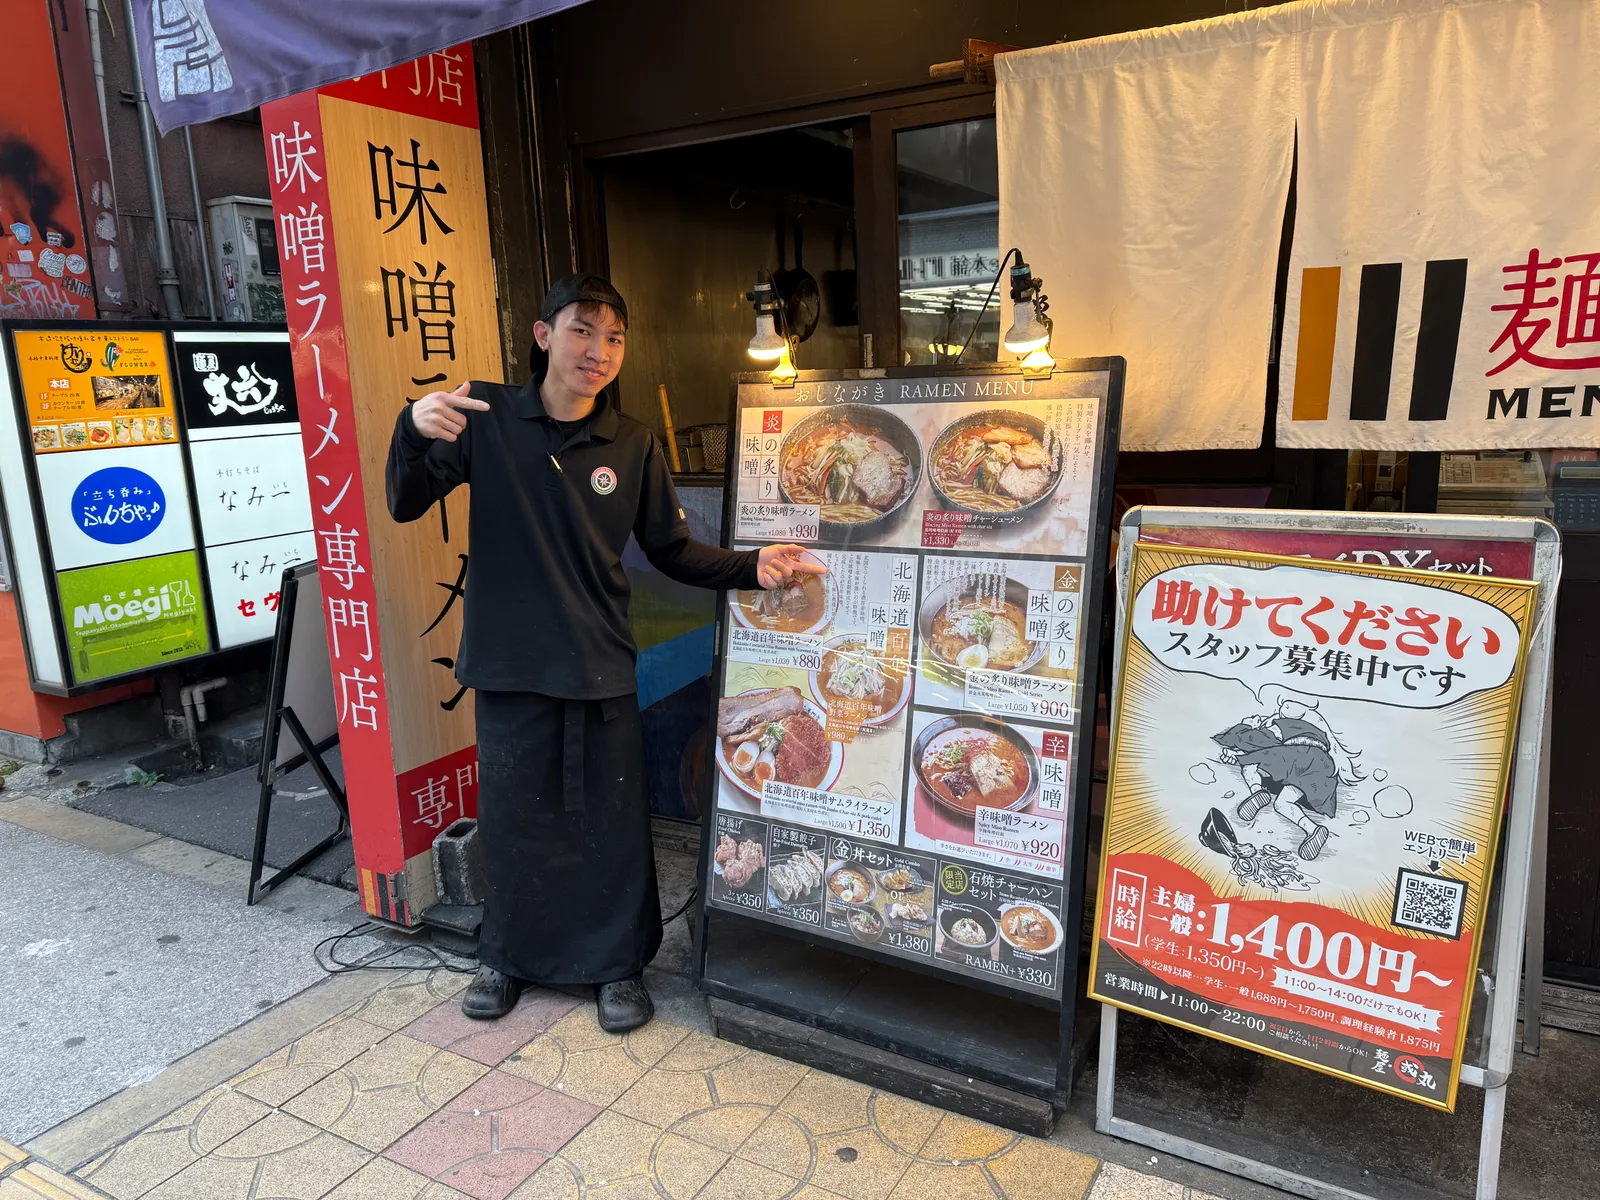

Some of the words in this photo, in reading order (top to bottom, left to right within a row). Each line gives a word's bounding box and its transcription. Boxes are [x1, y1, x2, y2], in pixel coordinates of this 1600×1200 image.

[49, 379, 70, 390] 本店
[794, 382, 886, 403] おしながき
[900, 382, 970, 400] RAMEN
[974, 379, 1035, 396] MENU
[269, 120, 379, 732] 味噌ラーメン専門店
[366, 137, 467, 712] 味噌メン
[744, 436, 759, 477] 味噌
[763, 413, 782, 499] 炎の炙り
[216, 465, 260, 479] 手打ちそば
[740, 504, 817, 517] 炎の炙り味噌ラーメン
[926, 512, 1025, 524] 炎の炙り味噌チャーシューメン
[755, 529, 768, 537] Large
[788, 524, 818, 539] ¥930
[923, 535, 950, 546] ¥1,330
[73, 583, 172, 629] Moegi
[1029, 593, 1051, 640] 味噌
[1055, 569, 1080, 666] 金の炙り
[869, 606, 886, 649] 味噌
[1151, 579, 1502, 660] 助けてください
[792, 653, 821, 670] ¥880
[1163, 630, 1467, 697] スタッフ募集中です
[968, 671, 1069, 693] 金の炙り味噌ラーメン
[987, 701, 1004, 710] Large
[1004, 702, 1028, 713] ¥1,050
[1031, 699, 1069, 719] ¥900
[827, 730, 846, 740] ¥980
[1042, 736, 1066, 810] 辛味噌
[764, 782, 892, 816] 北海道百年味噌サムライラーメン
[718, 816, 744, 830] 唐揚げ
[828, 819, 847, 830] ¥1,500
[848, 819, 891, 839] ¥1,350
[978, 808, 1049, 831] 辛味噌ラーメン
[978, 821, 991, 830] Spicy
[1002, 826, 1020, 834] Ramen
[773, 827, 817, 846] 自家製餃子
[978, 836, 996, 846] Large
[996, 838, 1019, 850] ¥1,070
[1021, 838, 1060, 859] ¥920
[1404, 829, 1477, 854] WEBで簡単
[890, 890, 905, 901] or
[968, 870, 1054, 899] 石焼チャーハン
[968, 886, 997, 901] セット
[736, 893, 762, 909] ¥350
[1114, 884, 1140, 932] 時給
[1149, 886, 1196, 912] 主婦
[792, 907, 820, 924] ¥350
[1147, 914, 1193, 938] 一般
[888, 933, 929, 953] ¥1,380
[1017, 966, 1053, 987] ¥330
[1105, 972, 1159, 1000] 営業時間
